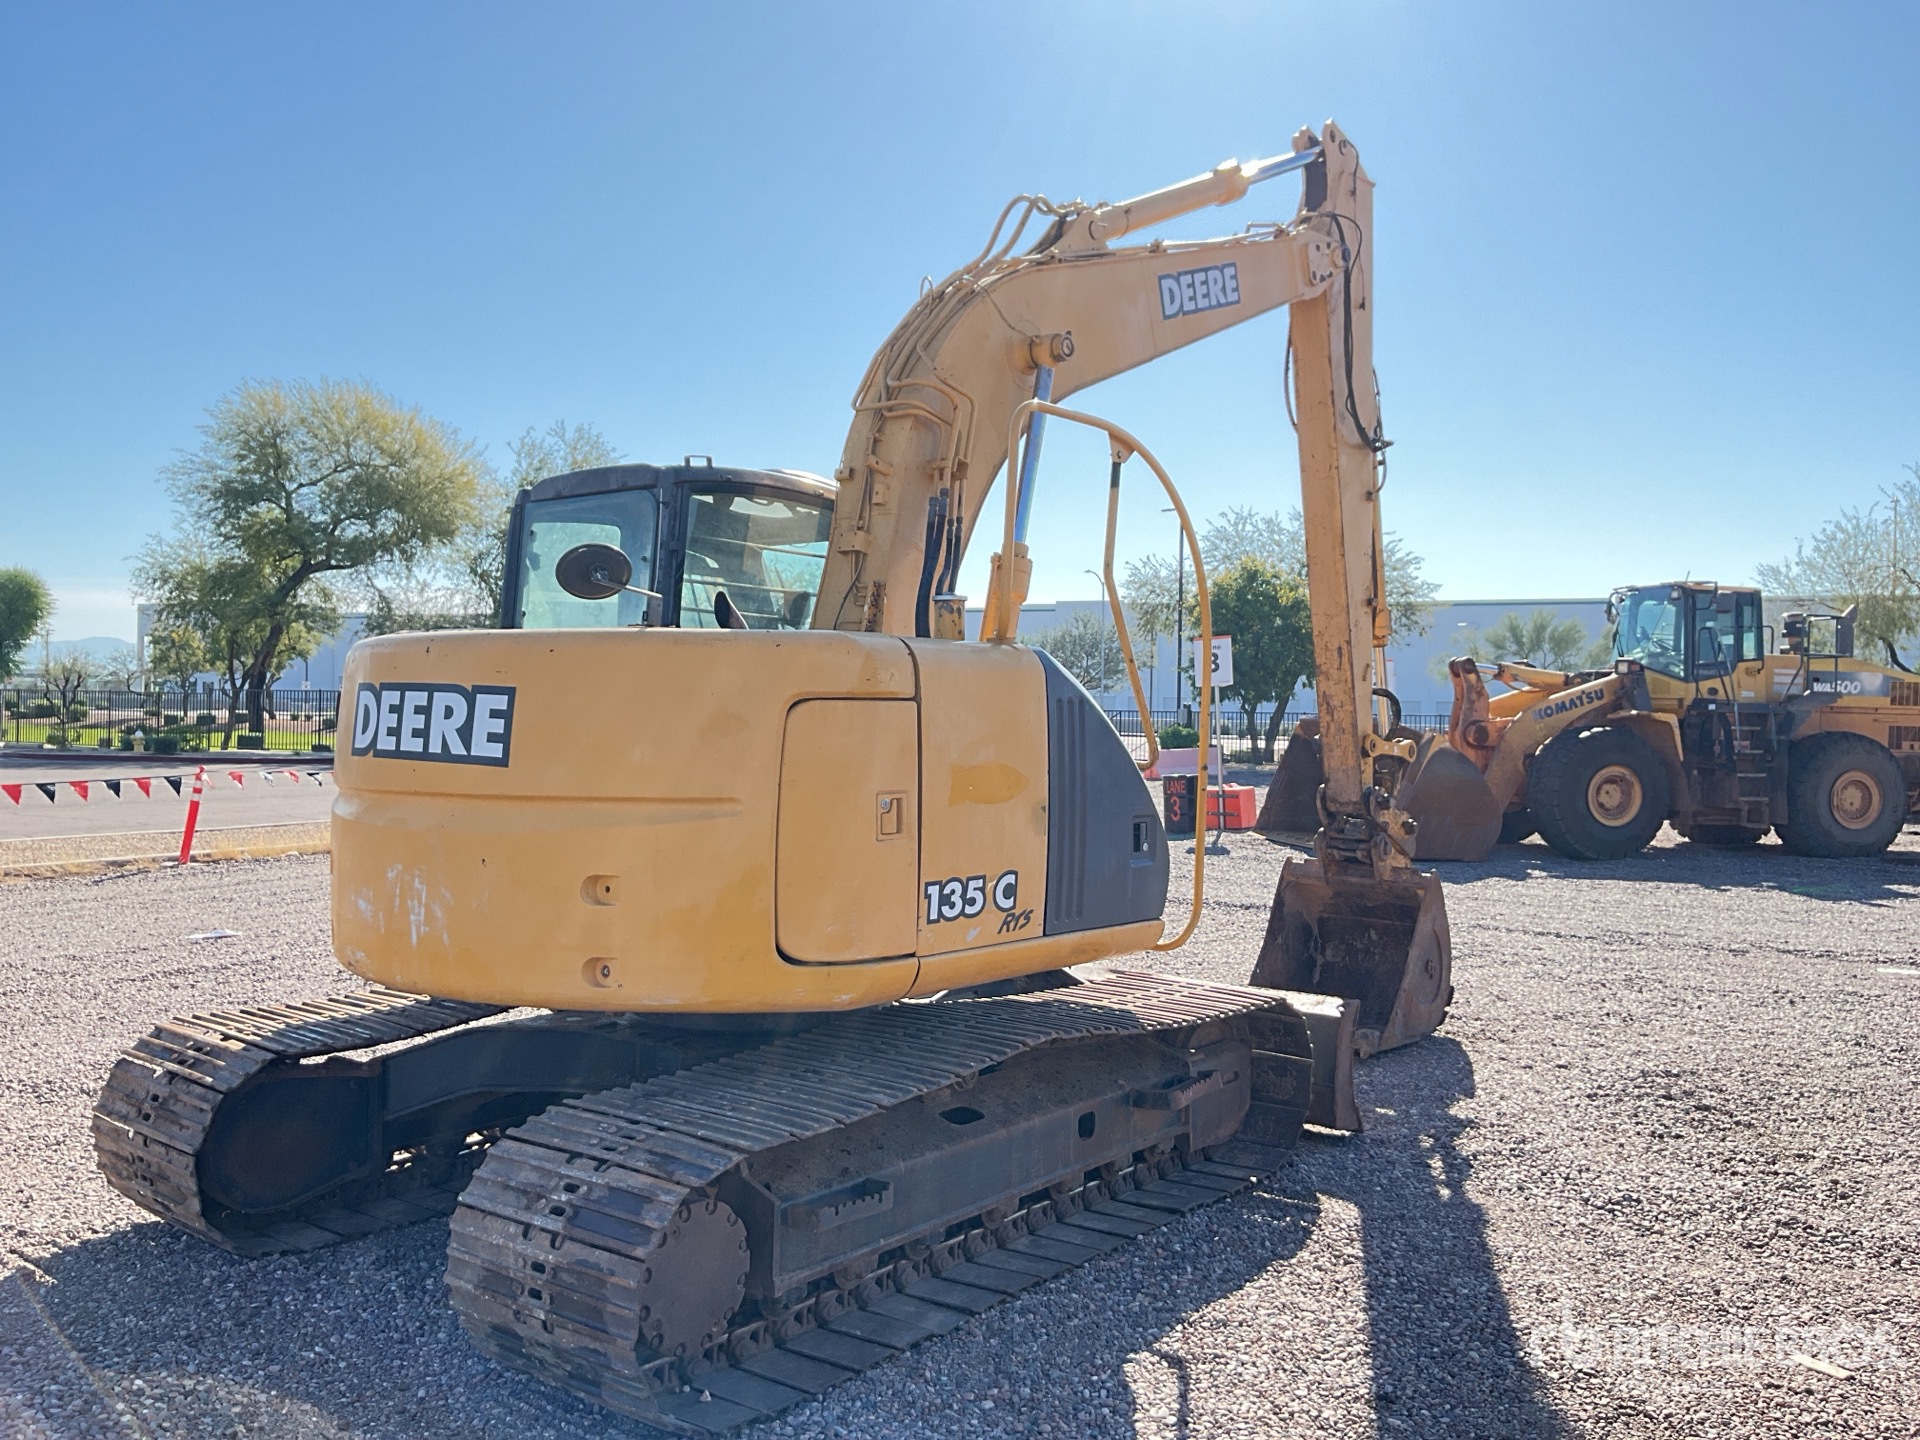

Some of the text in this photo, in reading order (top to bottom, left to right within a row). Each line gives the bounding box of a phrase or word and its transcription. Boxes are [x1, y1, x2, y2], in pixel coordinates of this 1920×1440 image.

[1159, 264, 1240, 317] DEERE
[1813, 680, 1861, 694] WA500
[1532, 688, 1604, 720] KOMATSU
[353, 687, 512, 761] DEERE
[1167, 780, 1185, 793] LANE
[1170, 795, 1180, 821] 3
[925, 871, 1017, 922] 135 C
